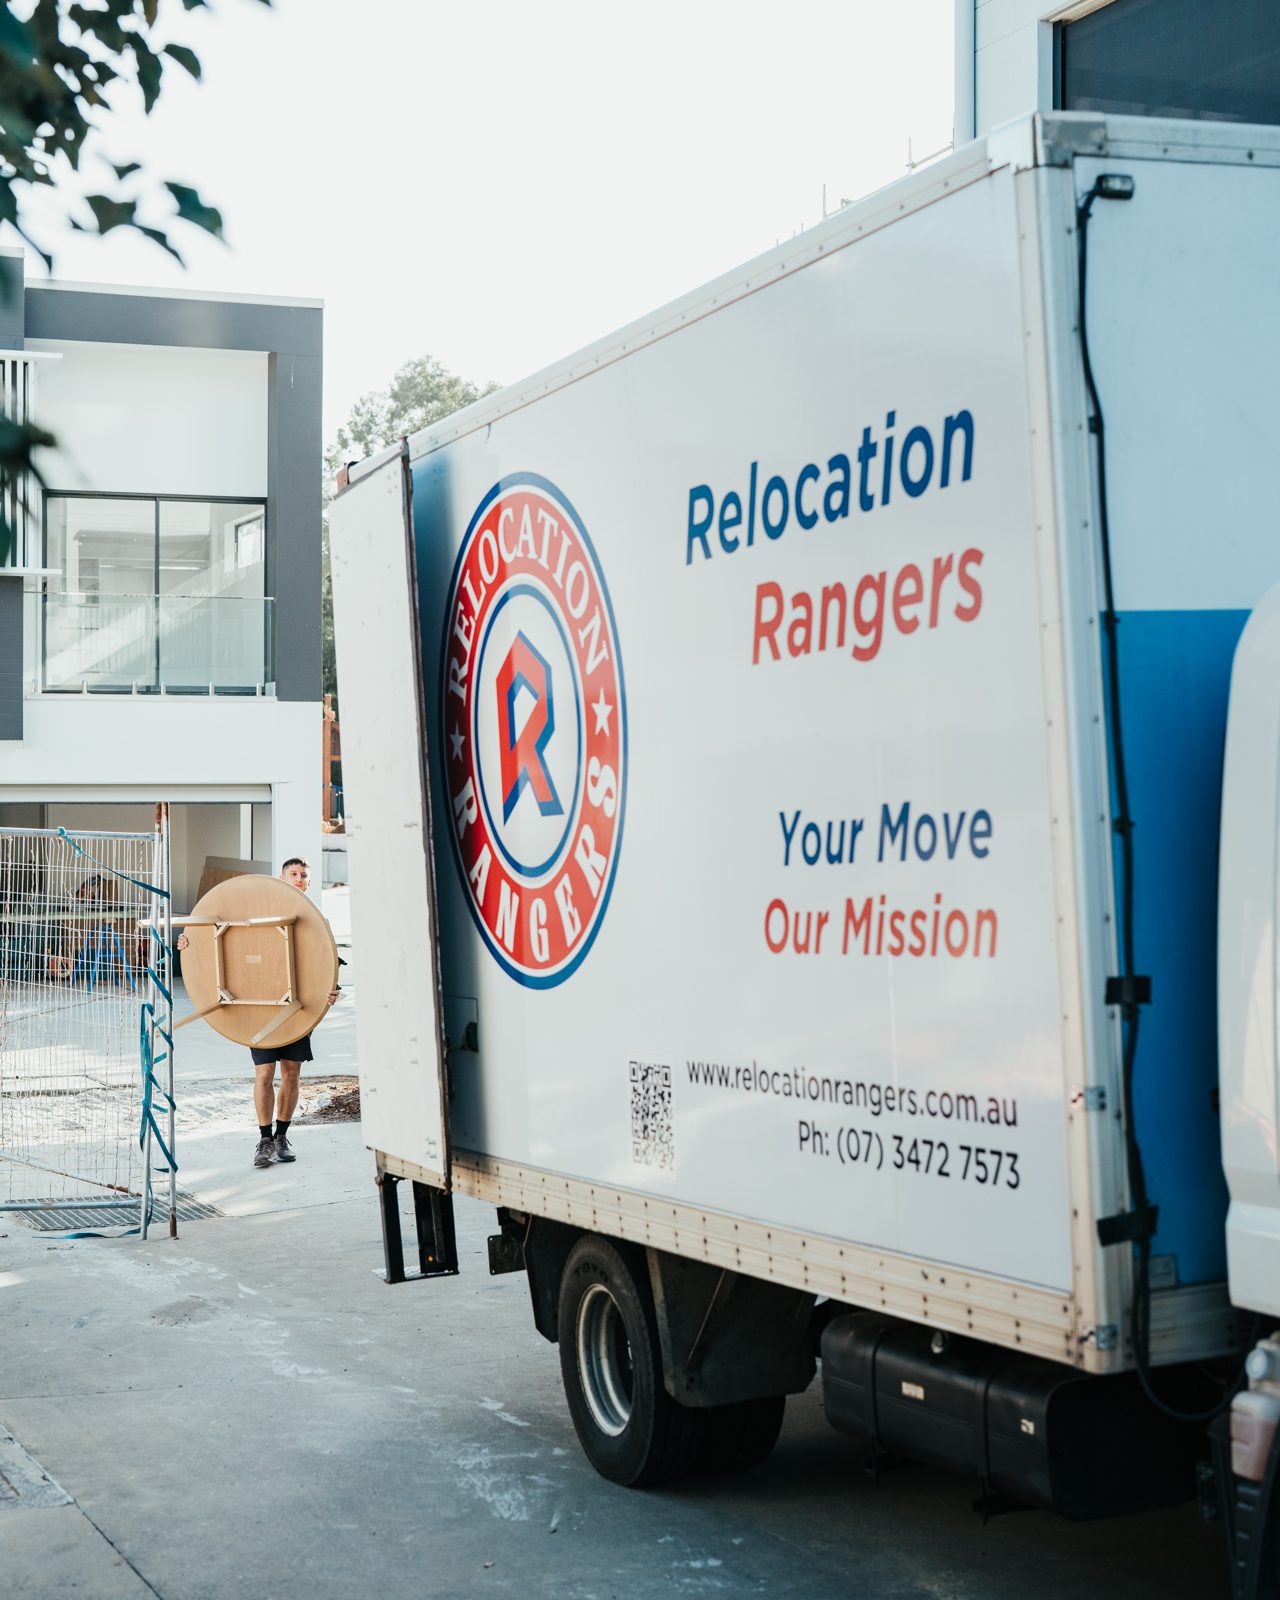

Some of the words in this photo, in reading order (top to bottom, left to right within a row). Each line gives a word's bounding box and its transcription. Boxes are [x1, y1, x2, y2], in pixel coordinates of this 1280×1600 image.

[686, 409, 975, 565] Relocation
[449, 503, 609, 706] RELOCATION
[752, 548, 984, 665] Rangers
[453, 755, 616, 963] RANGERS
[779, 810, 864, 866] Your
[877, 801, 992, 862] Move
[764, 898, 829, 954] Our
[842, 893, 998, 957] Mission
[686, 1060, 1018, 1127] www.relocationrangers.com.au
[799, 1120, 829, 1156] Ph:
[837, 1127, 884, 1171] (07)
[892, 1135, 950, 1178] 3472
[959, 1145, 1020, 1190] 7573
